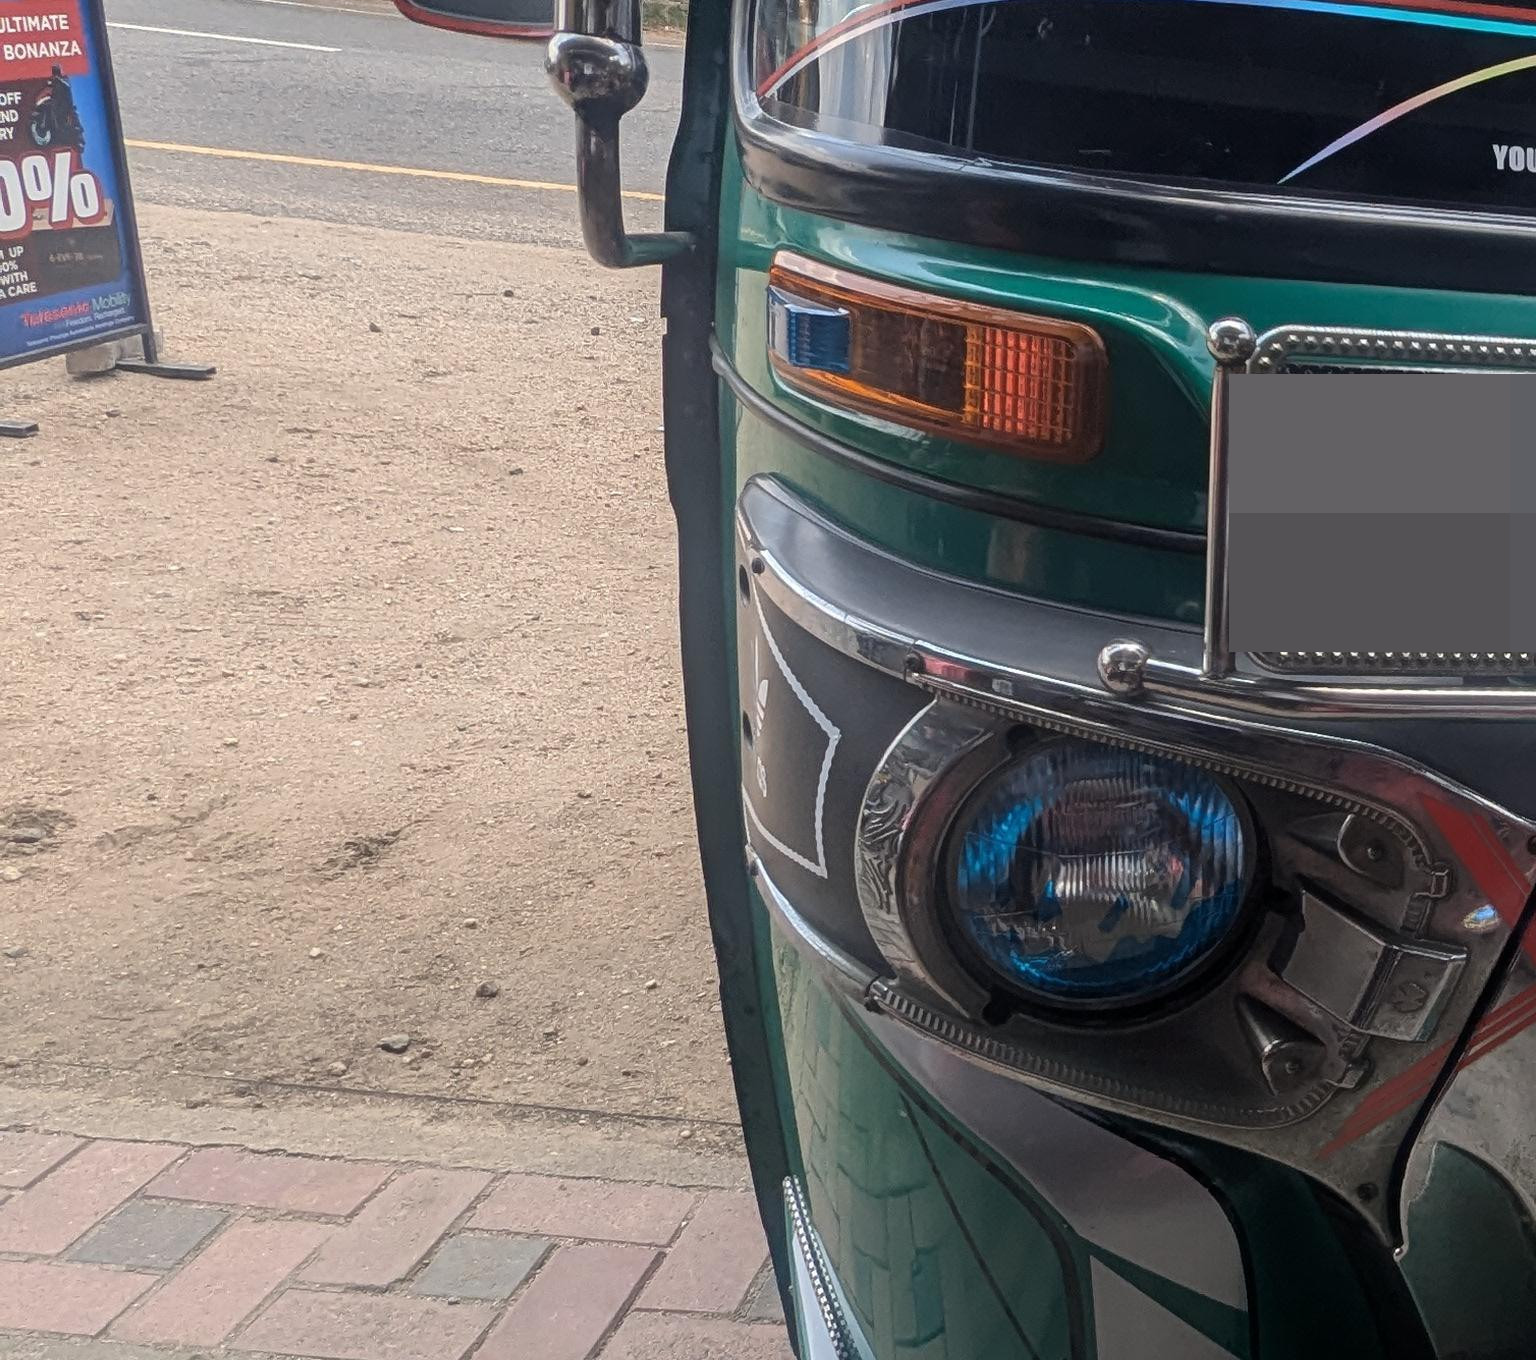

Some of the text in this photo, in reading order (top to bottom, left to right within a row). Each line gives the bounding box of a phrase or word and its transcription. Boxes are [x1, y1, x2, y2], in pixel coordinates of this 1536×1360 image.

[3, 40, 82, 61] BONANZA
[0, 91, 21, 106] OFF
[0, 109, 19, 124] ND
[8, 246, 24, 258] UP
[0, 260, 18, 273] 0%
[0, 271, 28, 286] WITH
[8, 281, 37, 297] CARE
